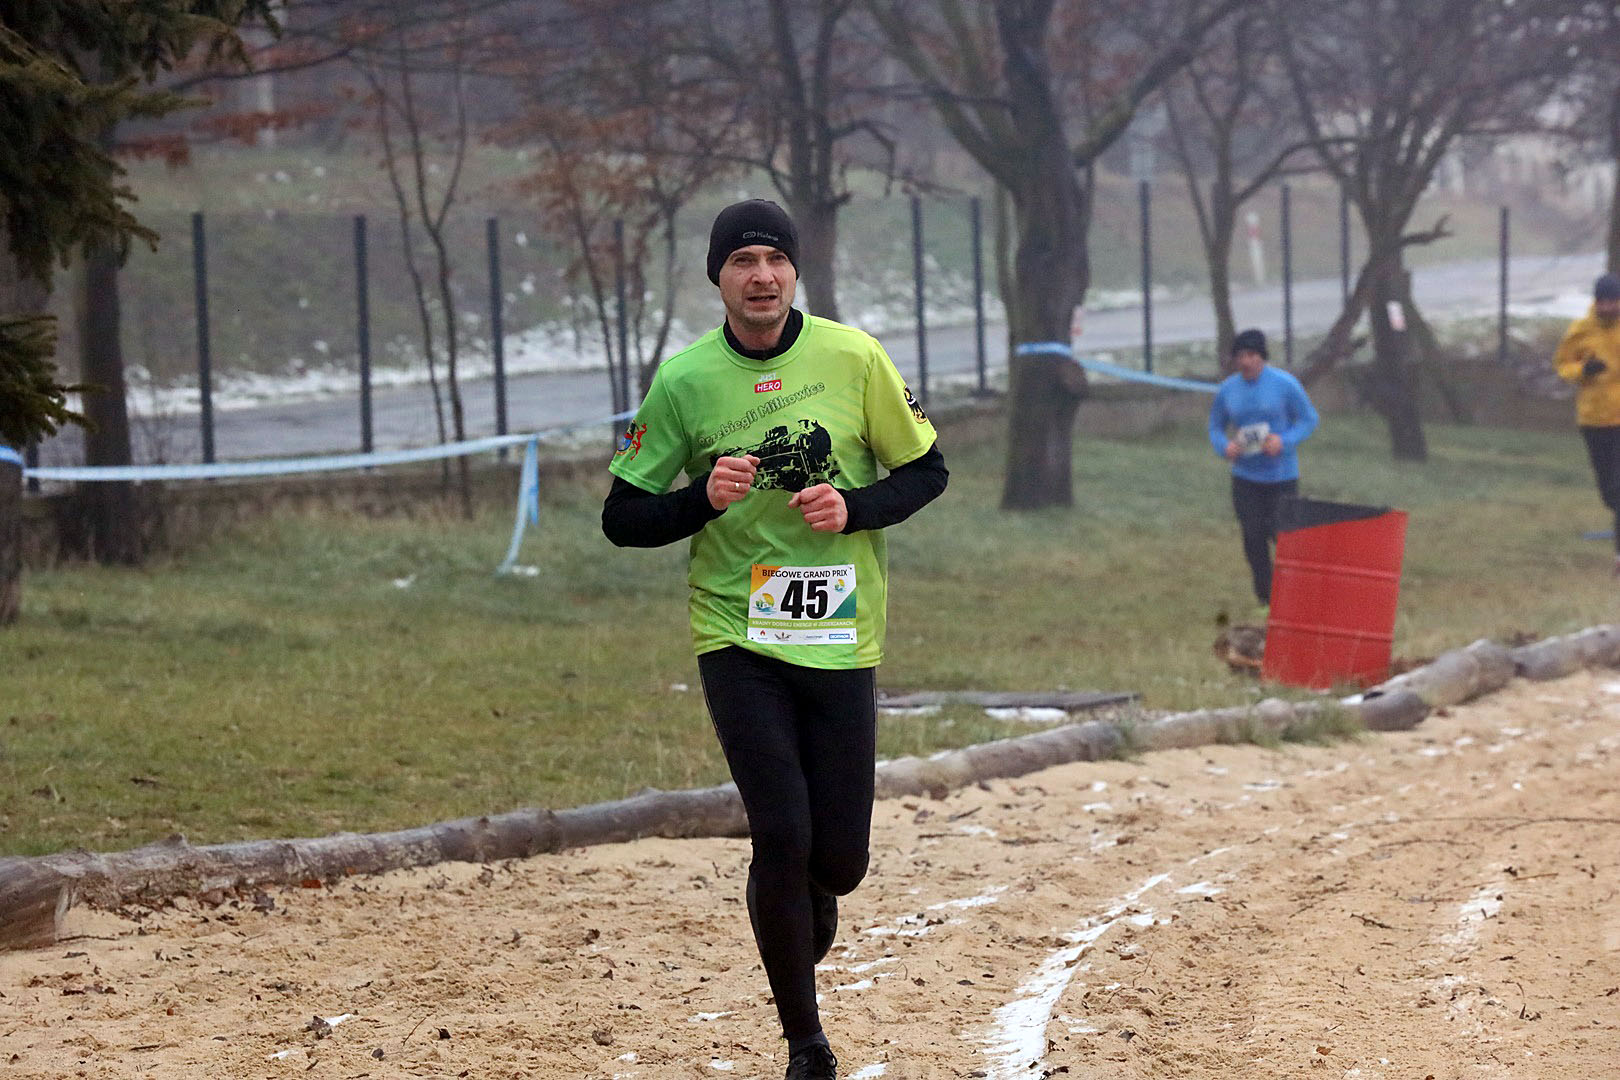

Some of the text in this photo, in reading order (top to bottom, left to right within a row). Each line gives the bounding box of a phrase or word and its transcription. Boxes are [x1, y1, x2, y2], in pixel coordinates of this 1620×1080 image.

[759, 372, 777, 382] JUST
[757, 381, 781, 392] HERO
[762, 569, 848, 579] BIEGOWE GRAND PRIX
[780, 579, 829, 620] 45
